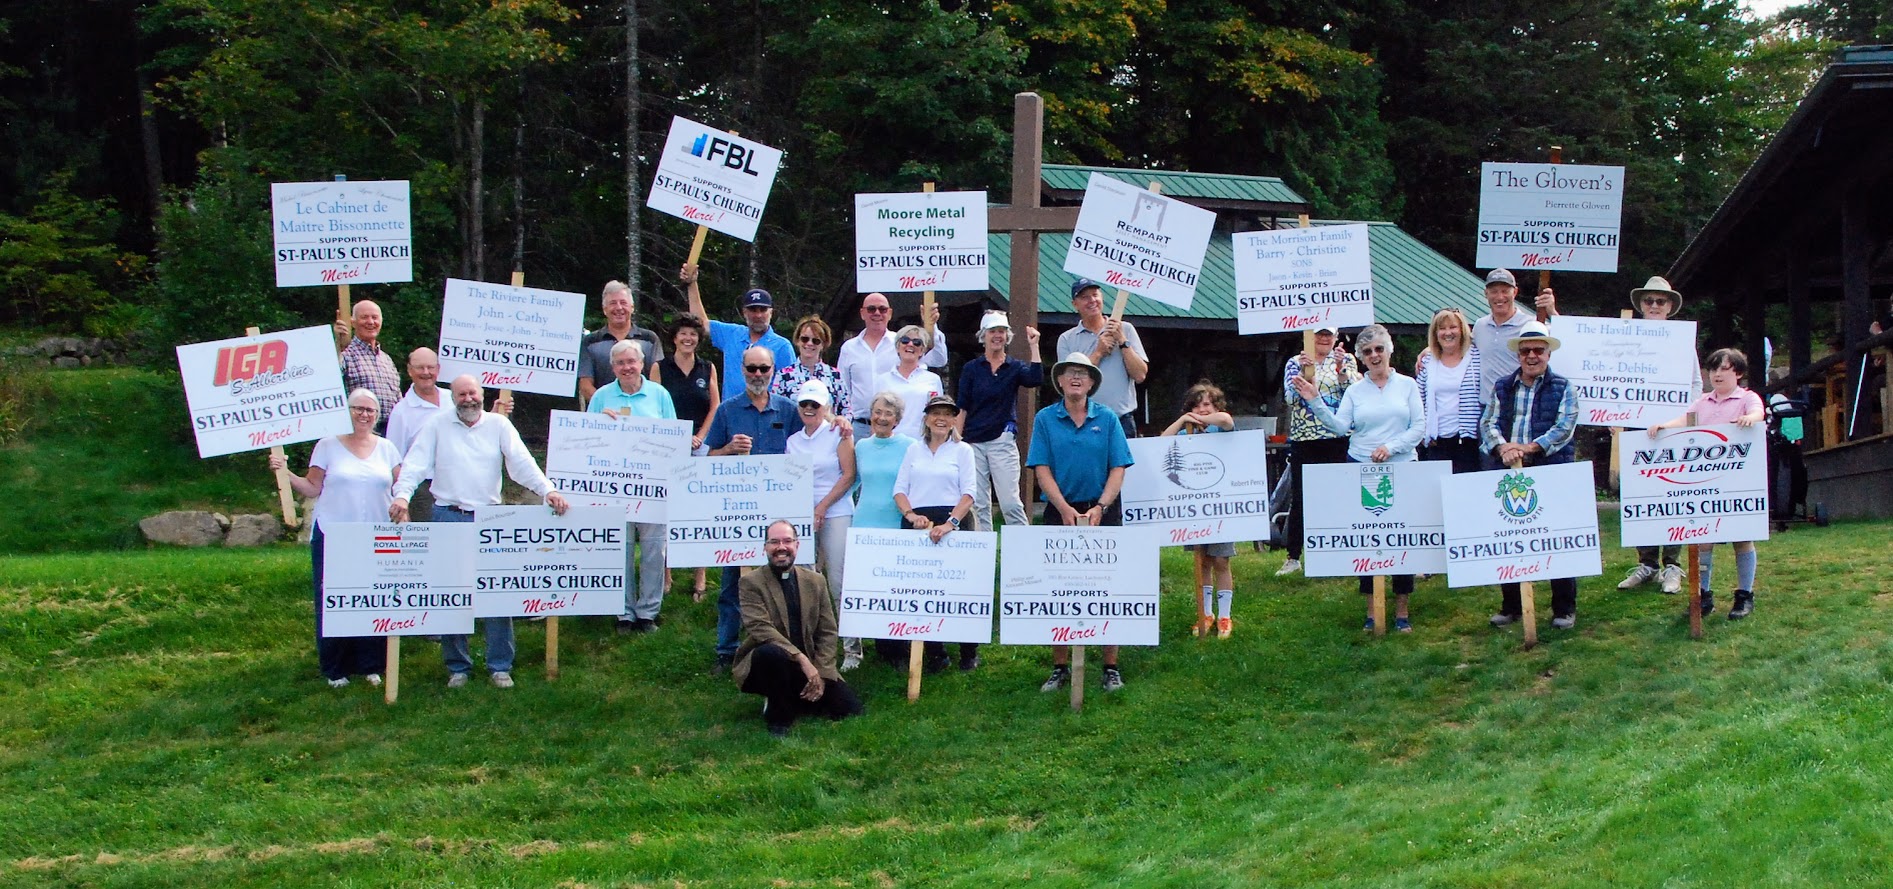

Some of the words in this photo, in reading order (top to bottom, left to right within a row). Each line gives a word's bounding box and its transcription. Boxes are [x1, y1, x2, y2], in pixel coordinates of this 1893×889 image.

[707, 137, 758, 177] FBL
[693, 176, 732, 194] SUPPORTS
[1493, 171, 1528, 187] The
[1536, 170, 1612, 190] Gloven's
[656, 175, 711, 202] ST-PAUL'S
[713, 194, 761, 219] CHURCH
[297, 202, 312, 215] Le
[317, 201, 369, 214] Cabinet
[373, 201, 388, 212] de
[878, 209, 922, 219] Moore
[927, 207, 965, 218] Metal
[1582, 201, 1610, 210] Gloven
[682, 206, 714, 222] Merci
[329, 220, 405, 231] Bissonnette
[1524, 220, 1575, 228] SUPPORTS
[889, 226, 955, 240] Recycling
[1248, 236, 1268, 247] The
[1272, 234, 1317, 244] Morrison
[1320, 230, 1353, 242] Family
[1480, 230, 1550, 244] ST-PAUL'S
[1555, 232, 1617, 246] CHURCH
[279, 247, 346, 261] ST-PAUL'S
[351, 246, 409, 258] CHURCH
[1115, 238, 1161, 258] SUPPORTS
[1257, 250, 1286, 260] Barry
[1297, 245, 1346, 256] Christine
[859, 255, 924, 268] ST-PAUL'S
[929, 254, 985, 267] CHURCH
[1073, 236, 1136, 266] ST-PAUL'S
[1140, 258, 1195, 286] CHURCH
[1292, 259, 1312, 268] SONS
[1522, 253, 1562, 267] Merci
[321, 267, 359, 282] Merci
[899, 275, 937, 289] Merci
[1106, 270, 1143, 288] Merci
[1280, 282, 1328, 290] SUPPORTS
[468, 287, 487, 299] The
[531, 295, 563, 309] Family
[1240, 293, 1306, 310] ST-PAUL'S
[1311, 289, 1370, 304] CHURCH
[478, 306, 504, 319] John
[516, 311, 549, 326] Cathy
[1282, 313, 1320, 329] Merci
[511, 326, 531, 336] John
[540, 329, 574, 341] Timothy
[1576, 323, 1596, 334] The
[1600, 324, 1632, 335] Havill
[1636, 326, 1671, 339] Family
[485, 339, 535, 350] SUPPORTS
[213, 340, 289, 388] IGA
[442, 345, 510, 364] ST-PAUL'S
[515, 353, 576, 372] CHURCH
[1582, 360, 1605, 371] Rob
[1618, 362, 1658, 374] Debbie
[249, 368, 289, 391] Albert
[481, 371, 521, 386] Merci
[1593, 375, 1645, 384] SUPPORTS
[240, 391, 296, 406] SUPPORTS
[1625, 388, 1689, 403] CHURCH
[196, 407, 273, 430] ST-PAUL'S
[278, 395, 345, 416] CHURCH
[1590, 409, 1632, 423] Merci
[557, 416, 578, 428] The
[582, 418, 617, 431] Palmer
[621, 423, 648, 433] Lowe
[652, 424, 686, 437] Family
[248, 424, 292, 447] Merci
[1632, 442, 1752, 465] NADON
[586, 455, 611, 467] Tom
[624, 458, 651, 471] Lynn
[711, 462, 769, 477] Hadley's
[1638, 464, 1687, 477] sport
[1689, 461, 1745, 473] LACHUTE
[592, 470, 644, 479] SUPPORTS
[624, 483, 667, 498] CHUR
[688, 480, 758, 494] Christmas
[763, 479, 793, 491] Tree
[1667, 488, 1719, 497] SUPPORTS
[723, 498, 758, 510] Farm
[1168, 492, 1221, 501] SUPPORTS
[1125, 505, 1197, 521] ST-PAUL'S
[1202, 500, 1266, 516] CHURCH
[1498, 506, 1544, 525] WENTWORTH
[1624, 502, 1695, 518] ST-PAUL'S
[1701, 498, 1765, 514] CHURCH
[715, 514, 767, 522] SUPPORTS
[670, 526, 742, 540] ST-PAUL'S
[1352, 522, 1405, 530] SUPPORTS
[1494, 527, 1549, 538] SUPPORTS
[1668, 524, 1709, 541] Merci
[480, 528, 620, 544] ST-EUSTACHE
[855, 534, 914, 547] Félicitations
[947, 538, 988, 549] Carrière
[1170, 525, 1212, 543] Merci
[1307, 534, 1380, 549] ST-PAUL'S
[1045, 538, 1117, 550] ROLAND
[1450, 541, 1524, 560] ST-PAUL'S
[1530, 534, 1596, 552] CHURCH
[714, 548, 756, 564] Merci
[897, 555, 945, 568] Honorary
[1044, 550, 1118, 564] MÉNARD
[1353, 556, 1395, 573] Merci
[1497, 562, 1540, 580] Merci
[873, 566, 934, 580] Chairperson
[937, 569, 966, 580] 2022!
[477, 576, 551, 590] ST-PAUL'S
[557, 575, 622, 588] CHURCH
[891, 588, 945, 596] SUPPORTS
[326, 594, 401, 609] ST-PAUL'S
[408, 594, 472, 607] CHURCH
[523, 597, 566, 614] Merci
[844, 597, 918, 613] ST-PAUL'S
[924, 600, 990, 616] CHURCH
[1004, 602, 1081, 616] ST-PAUL'S
[1088, 602, 1156, 616] CHURCH
[373, 616, 415, 633] Merci
[888, 622, 932, 636] Merci
[1051, 625, 1096, 642] Merci
